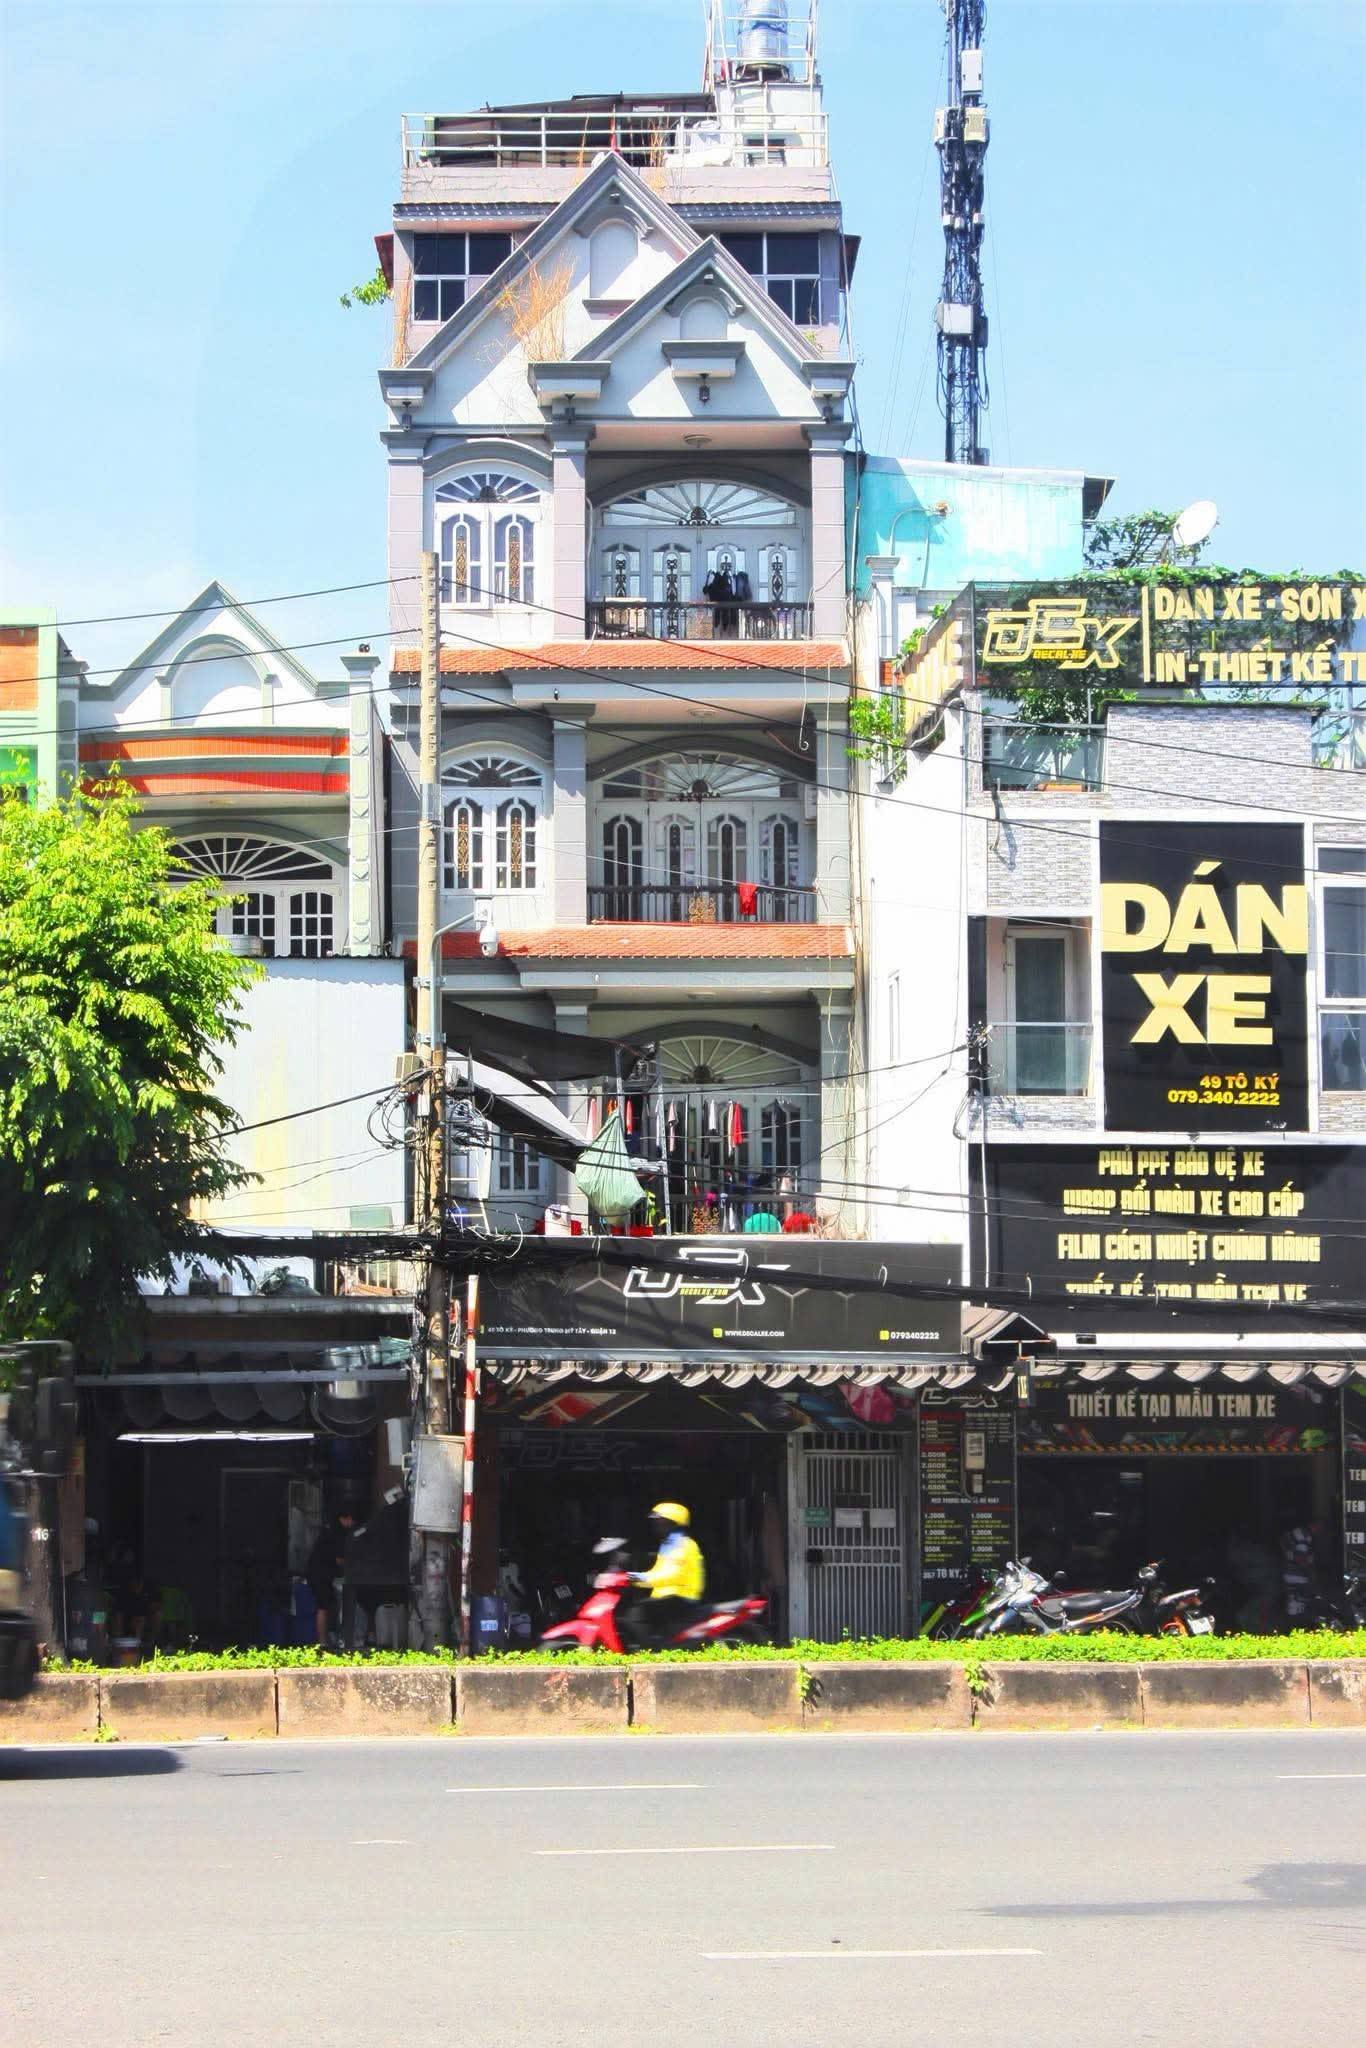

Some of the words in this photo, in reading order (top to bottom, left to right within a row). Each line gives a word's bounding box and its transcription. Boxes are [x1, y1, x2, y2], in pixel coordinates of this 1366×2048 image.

[1222, 587, 1262, 620] XE
[1281, 582, 1342, 622] SƠN
[1292, 638, 1334, 682] KẾ
[1099, 861, 1309, 954] DÁN
[1129, 973, 1273, 1045] XE
[1167, 1089, 1280, 1105] 079.340.2222
[1200, 1075, 1222, 1089] 49
[1225, 1072, 1248, 1089] TÔ
[1254, 1072, 1279, 1090] KÝ
[1137, 1151, 1170, 1176] PPF
[1214, 1146, 1237, 1181] VỆ
[1242, 1151, 1265, 1176] XE
[1154, 1183, 1196, 1215] MÀU
[1200, 1190, 1223, 1216] XE
[1228, 1191, 1264, 1217] CAO
[1268, 1180, 1305, 1217] CẤP
[1058, 1234, 1101, 1260] FILM
[1105, 1228, 1152, 1261] CÁCH
[1067, 1387, 1112, 1417] THIẾT
[1116, 1387, 1138, 1417] KẾ
[1140, 1393, 1171, 1423] TẠO
[1175, 1386, 1213, 1417] MẪU
[1217, 1393, 1251, 1417] TEM
[1256, 1393, 1276, 1417] XE
